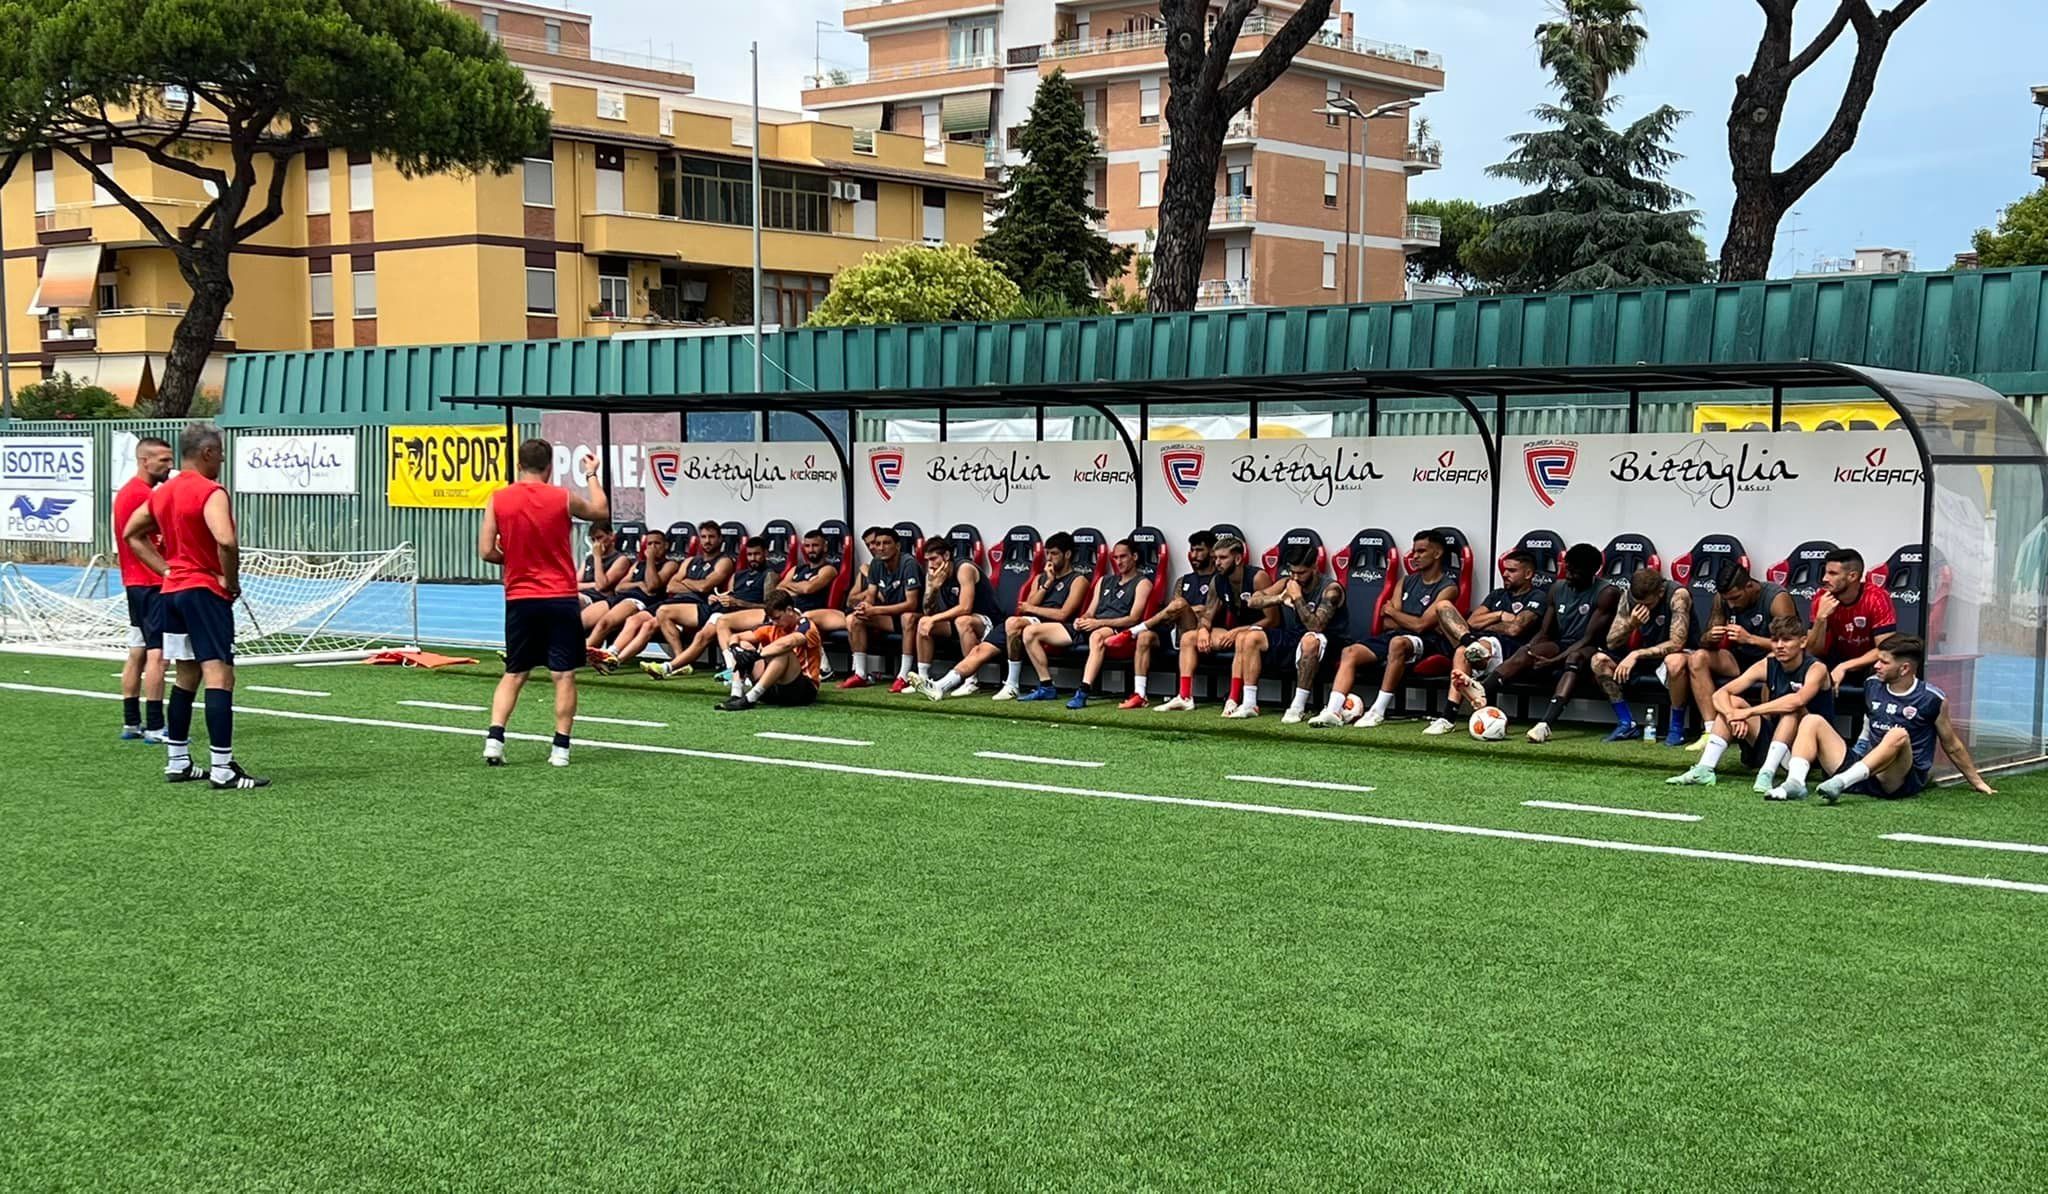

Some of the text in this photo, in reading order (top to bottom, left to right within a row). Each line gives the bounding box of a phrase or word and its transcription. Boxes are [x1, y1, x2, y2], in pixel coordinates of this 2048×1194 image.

[3, 451, 84, 473] ISOTRAS
[247, 442, 341, 487] Bizzaglia
[552, 444, 645, 487] POME
[683, 453, 786, 502] Bizzaglia
[790, 469, 837, 483] KICKBACK
[926, 450, 1051, 503] Bizzaglia
[1073, 470, 1136, 484] KICKBACK
[1232, 447, 1384, 506] Bizzaglia
[1413, 468, 1488, 484] KICKBACK
[1609, 443, 1799, 509] Bizzaglia
[1834, 467, 1925, 486] KICKBACK
[8, 516, 70, 533] PEGASO
